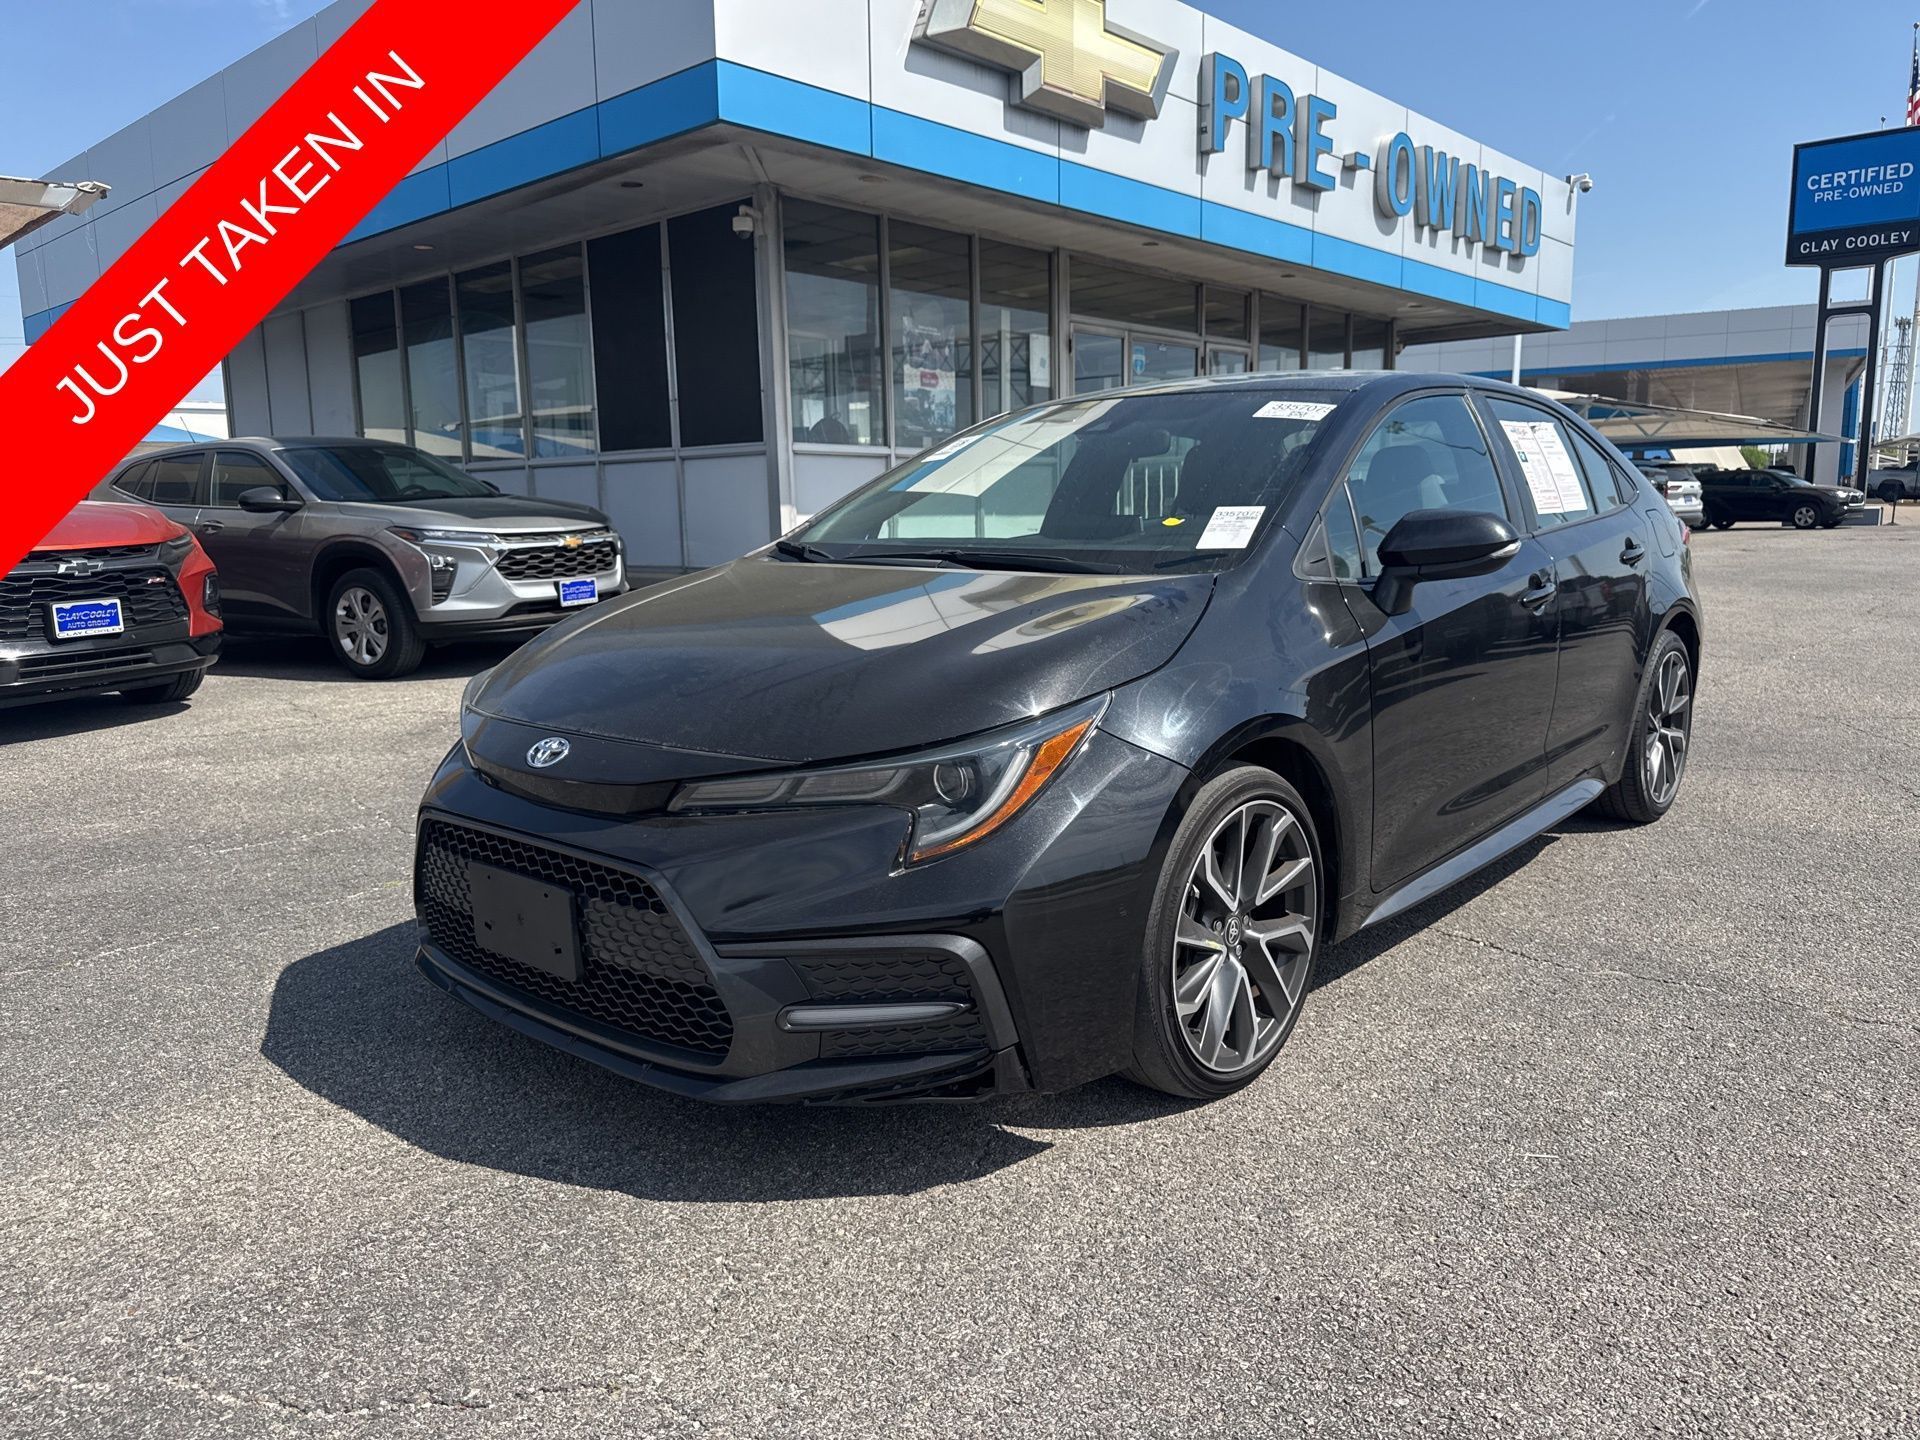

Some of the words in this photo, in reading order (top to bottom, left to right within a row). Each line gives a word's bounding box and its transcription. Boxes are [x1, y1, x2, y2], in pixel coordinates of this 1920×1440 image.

[1807, 162, 1914, 190] CERTIFIED
[1814, 182, 1904, 203] PRE-OWNED
[1800, 238, 1840, 254] CLAY
[1845, 230, 1911, 249] COOLEY
[67, 621, 86, 629] AUTO
[87, 619, 110, 627] GROUP
